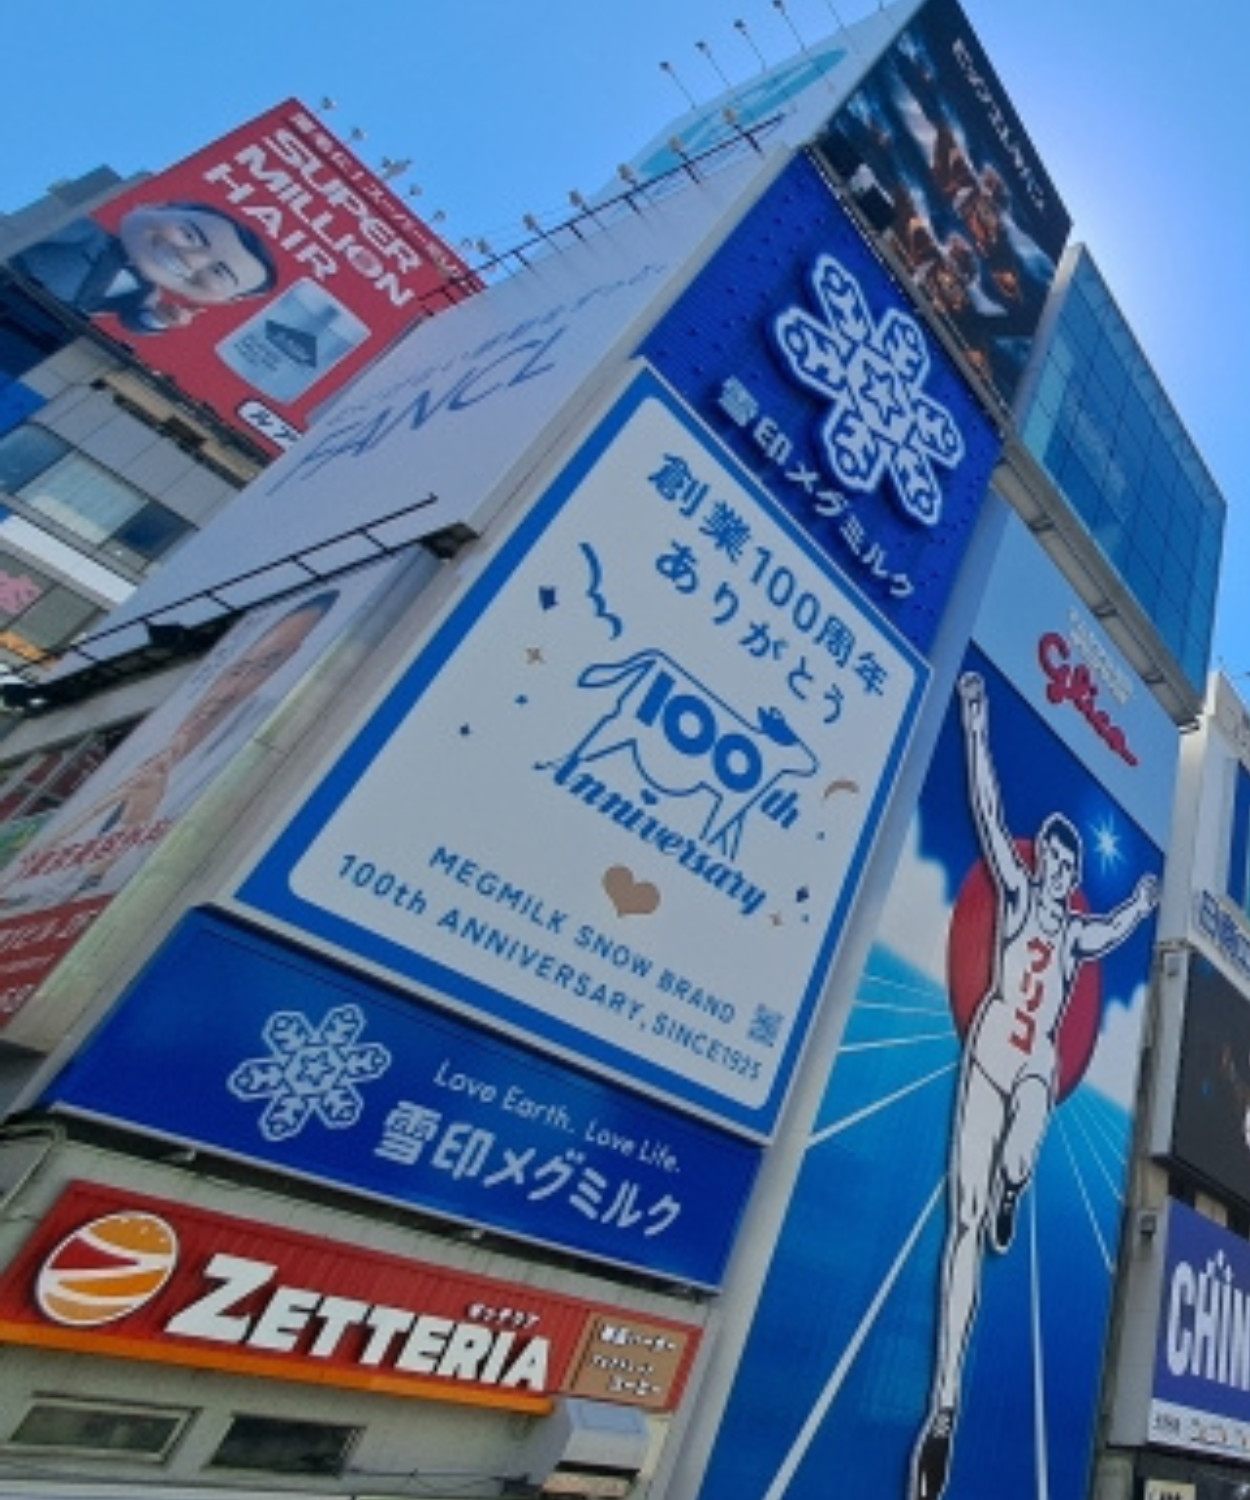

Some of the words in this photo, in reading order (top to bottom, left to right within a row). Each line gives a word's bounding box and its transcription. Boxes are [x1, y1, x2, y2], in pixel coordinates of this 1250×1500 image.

[204, 163, 336, 281] HAIR
[234, 144, 414, 306] MILLION
[263, 128, 422, 273] SUPER
[719, 376, 915, 598] 雪印メグミルク
[648, 453, 889, 696] 創業100周年
[655, 541, 845, 724] ありがとう
[1038, 632, 1138, 767] Glico
[339, 854, 427, 915] 100th
[533, 754, 768, 916] Anniversary
[430, 846, 568, 934] MEGMILK
[574, 925, 653, 978] SNOW
[656, 967, 736, 1024] BRAND
[1009, 937, 1055, 1055] グリコ
[374, 1100, 683, 1238] 雪印メグミルク
[434, 1060, 497, 1103] Love
[502, 1088, 575, 1135] Earth.
[585, 1120, 636, 1156] Love
[640, 1129, 682, 1174] Life.
[164, 1252, 550, 1392] ZETTERIA
